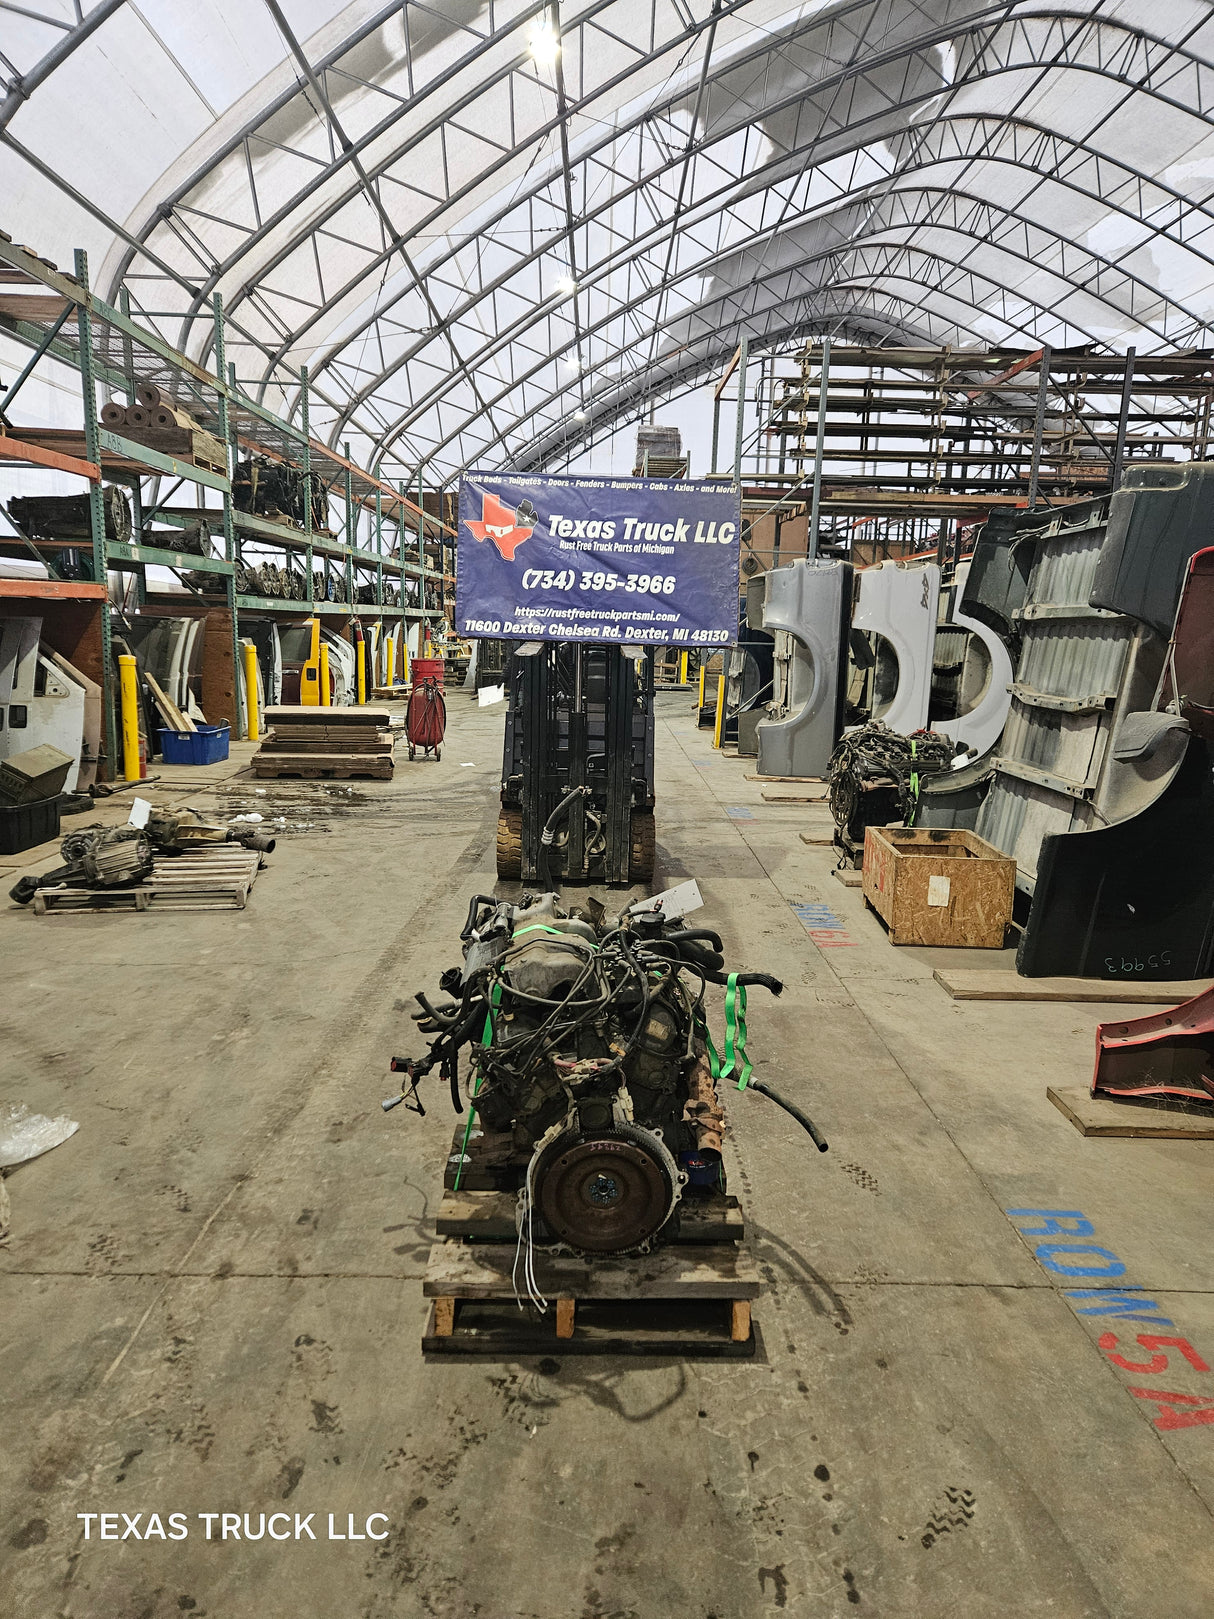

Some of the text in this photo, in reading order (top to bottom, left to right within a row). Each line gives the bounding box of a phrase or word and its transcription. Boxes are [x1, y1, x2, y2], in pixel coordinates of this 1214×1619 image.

[462, 474, 483, 483] Truck
[484, 475, 502, 483] Beds
[509, 476, 541, 487] Tailgates
[548, 479, 569, 487] Doors
[576, 480, 605, 489] Fenders
[611, 481, 643, 491] Bumpers
[650, 482, 668, 490] Cabs
[674, 484, 694, 492] Axles
[701, 485, 714, 493] and
[716, 485, 738, 494] More!
[548, 514, 736, 545] Texas Truck LLC
[560, 540, 674, 555] Rust Free Truck Parts of Michigan
[522, 568, 677, 595] (734) 395-3966
[514, 606, 681, 623] https://rustfreetruckpartsmi.com/
[465, 620, 729, 642] 11600 Dexter Chelsea Rd. Dexter, MI 48130
[789, 903, 846, 930] ROW
[1104, 950, 1172, 973] 55993
[1005, 1208, 1214, 1430] ROW 5A
